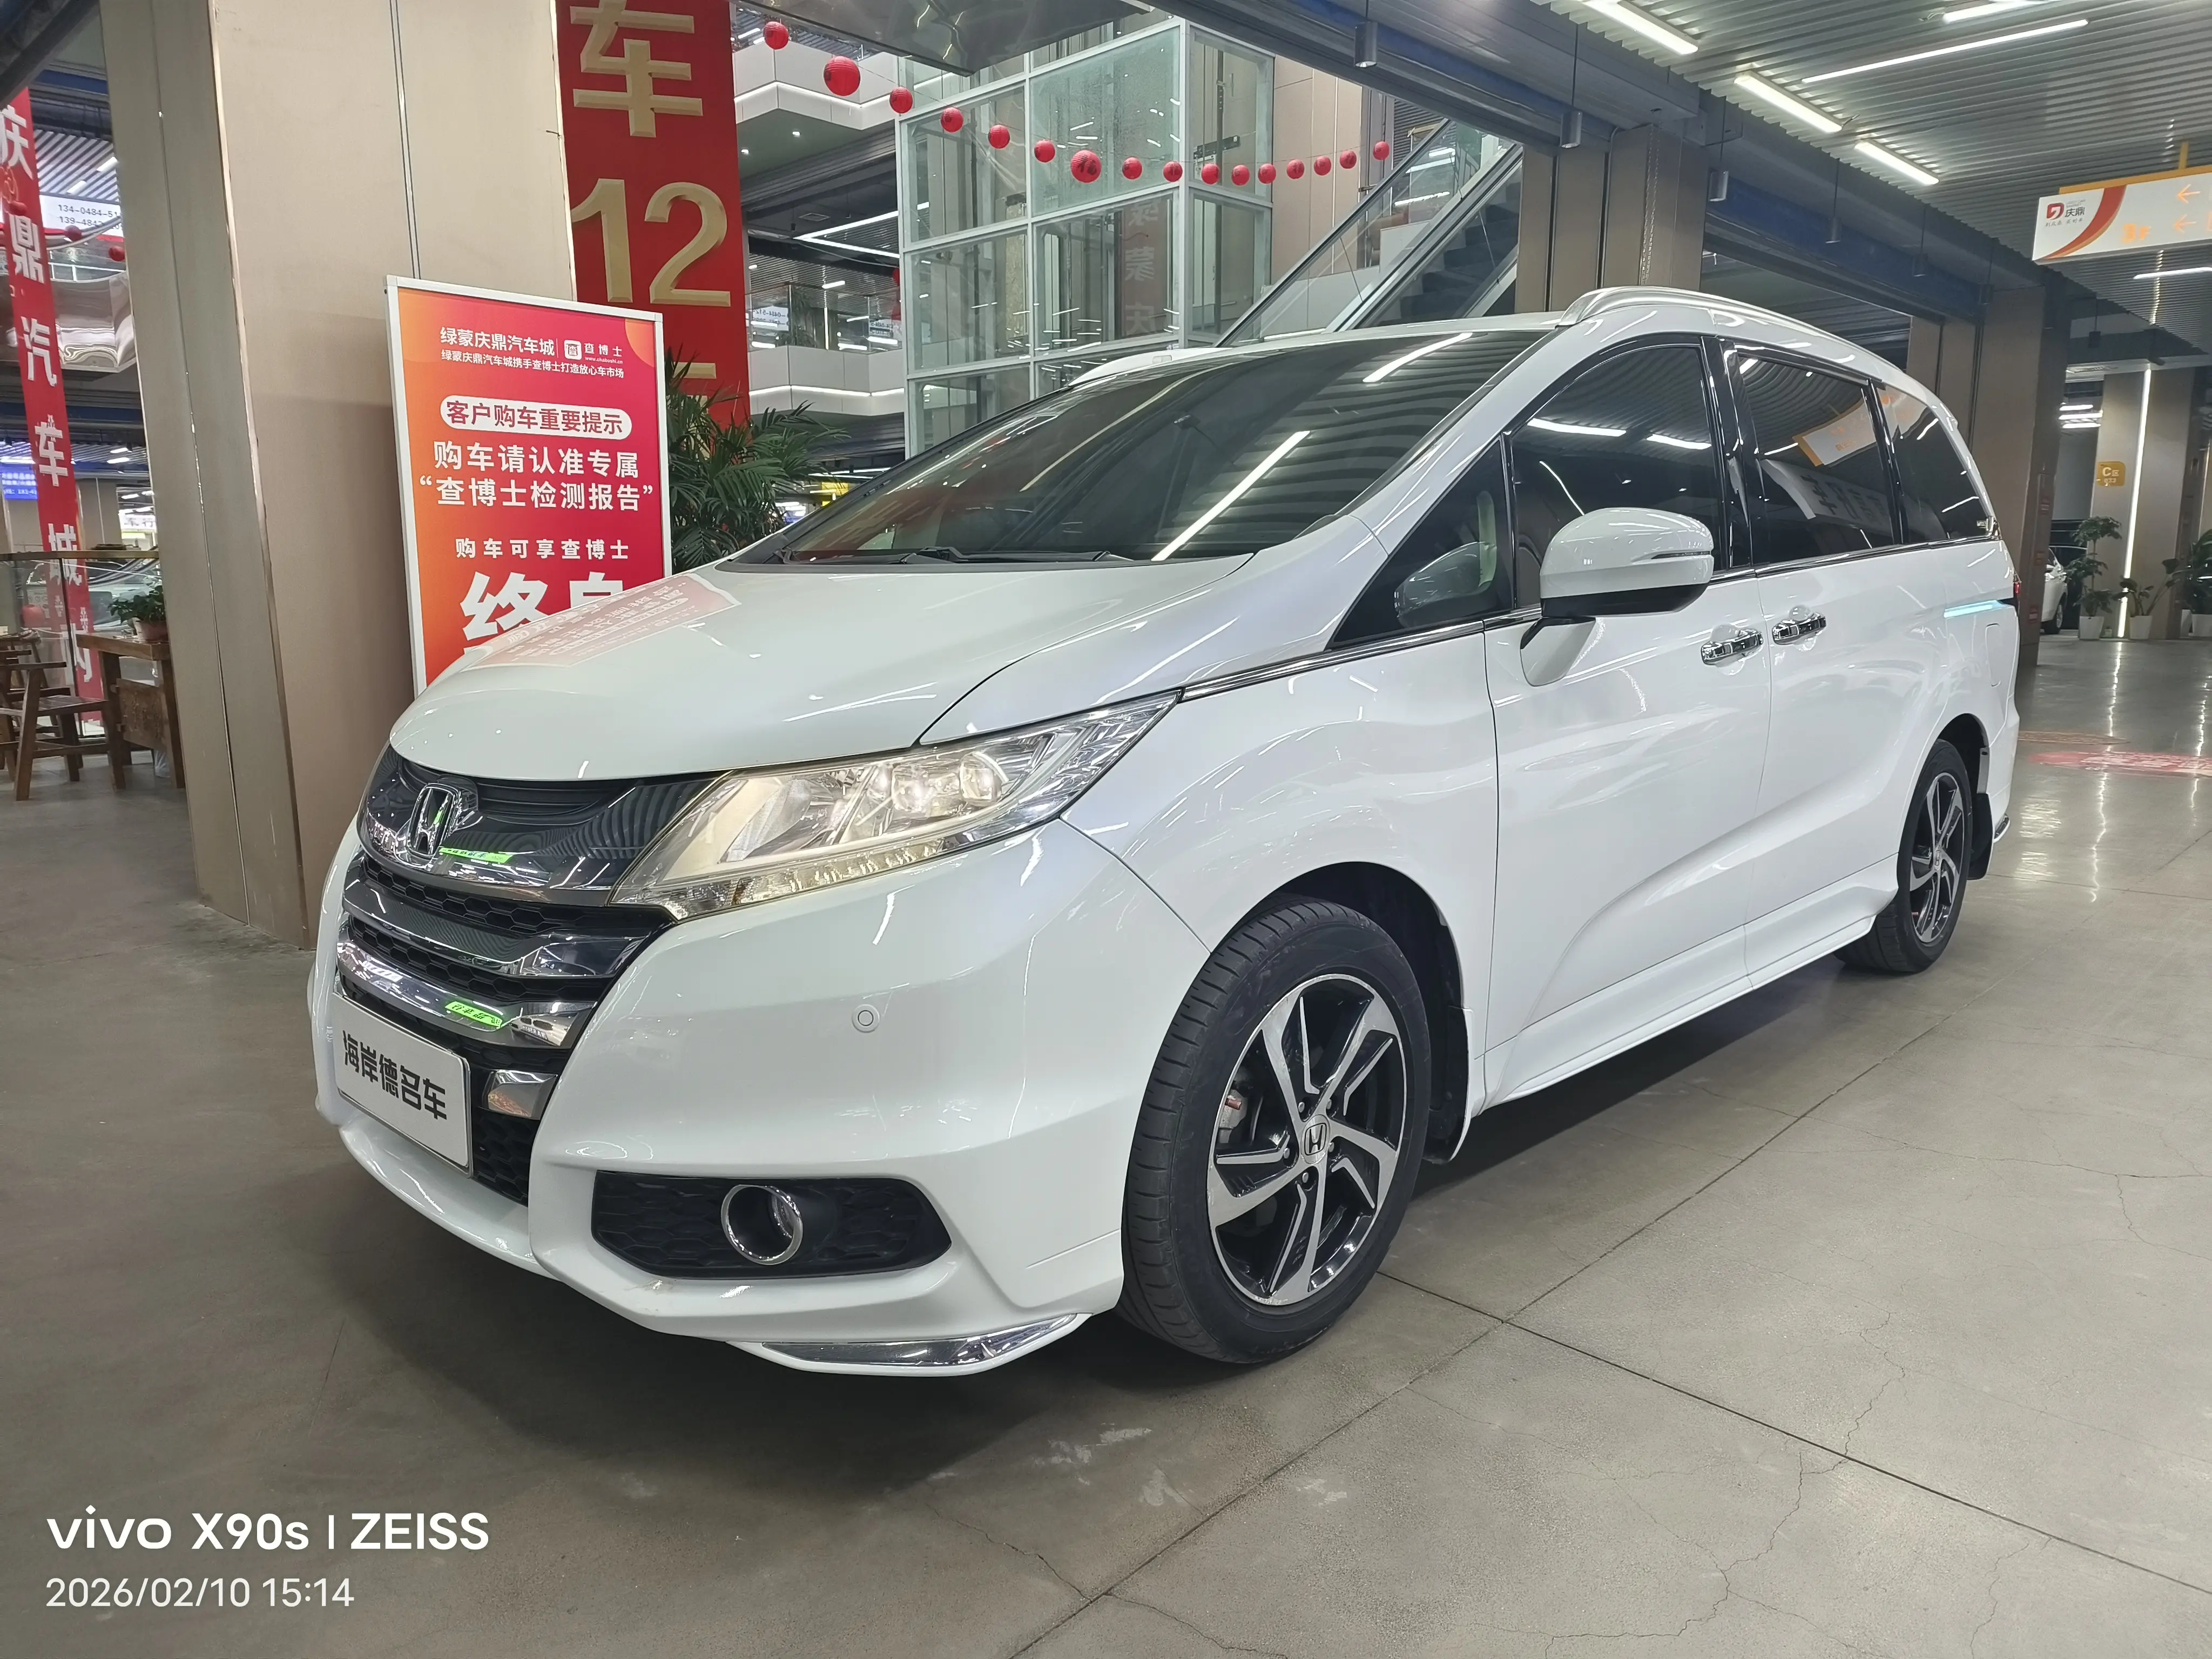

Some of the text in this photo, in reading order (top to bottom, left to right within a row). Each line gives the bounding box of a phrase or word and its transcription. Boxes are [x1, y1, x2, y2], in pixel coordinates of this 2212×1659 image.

[570, 0, 731, 307] 车 12
[2065, 206, 2085, 218] 庆鼎
[2122, 223, 2152, 244] 3F
[440, 326, 555, 356] 绿蒙庆鼎汽车城
[584, 342, 623, 357] 查博士
[441, 348, 624, 379] 绿蒙庆鼎汽车城携手查博士打造放心车市场
[446, 400, 623, 435] 客户购车重要提示
[433, 440, 639, 478] 购车请认准专属
[455, 538, 630, 560] 购车可享查博士
[342, 1030, 447, 1121] 海岸德名车
